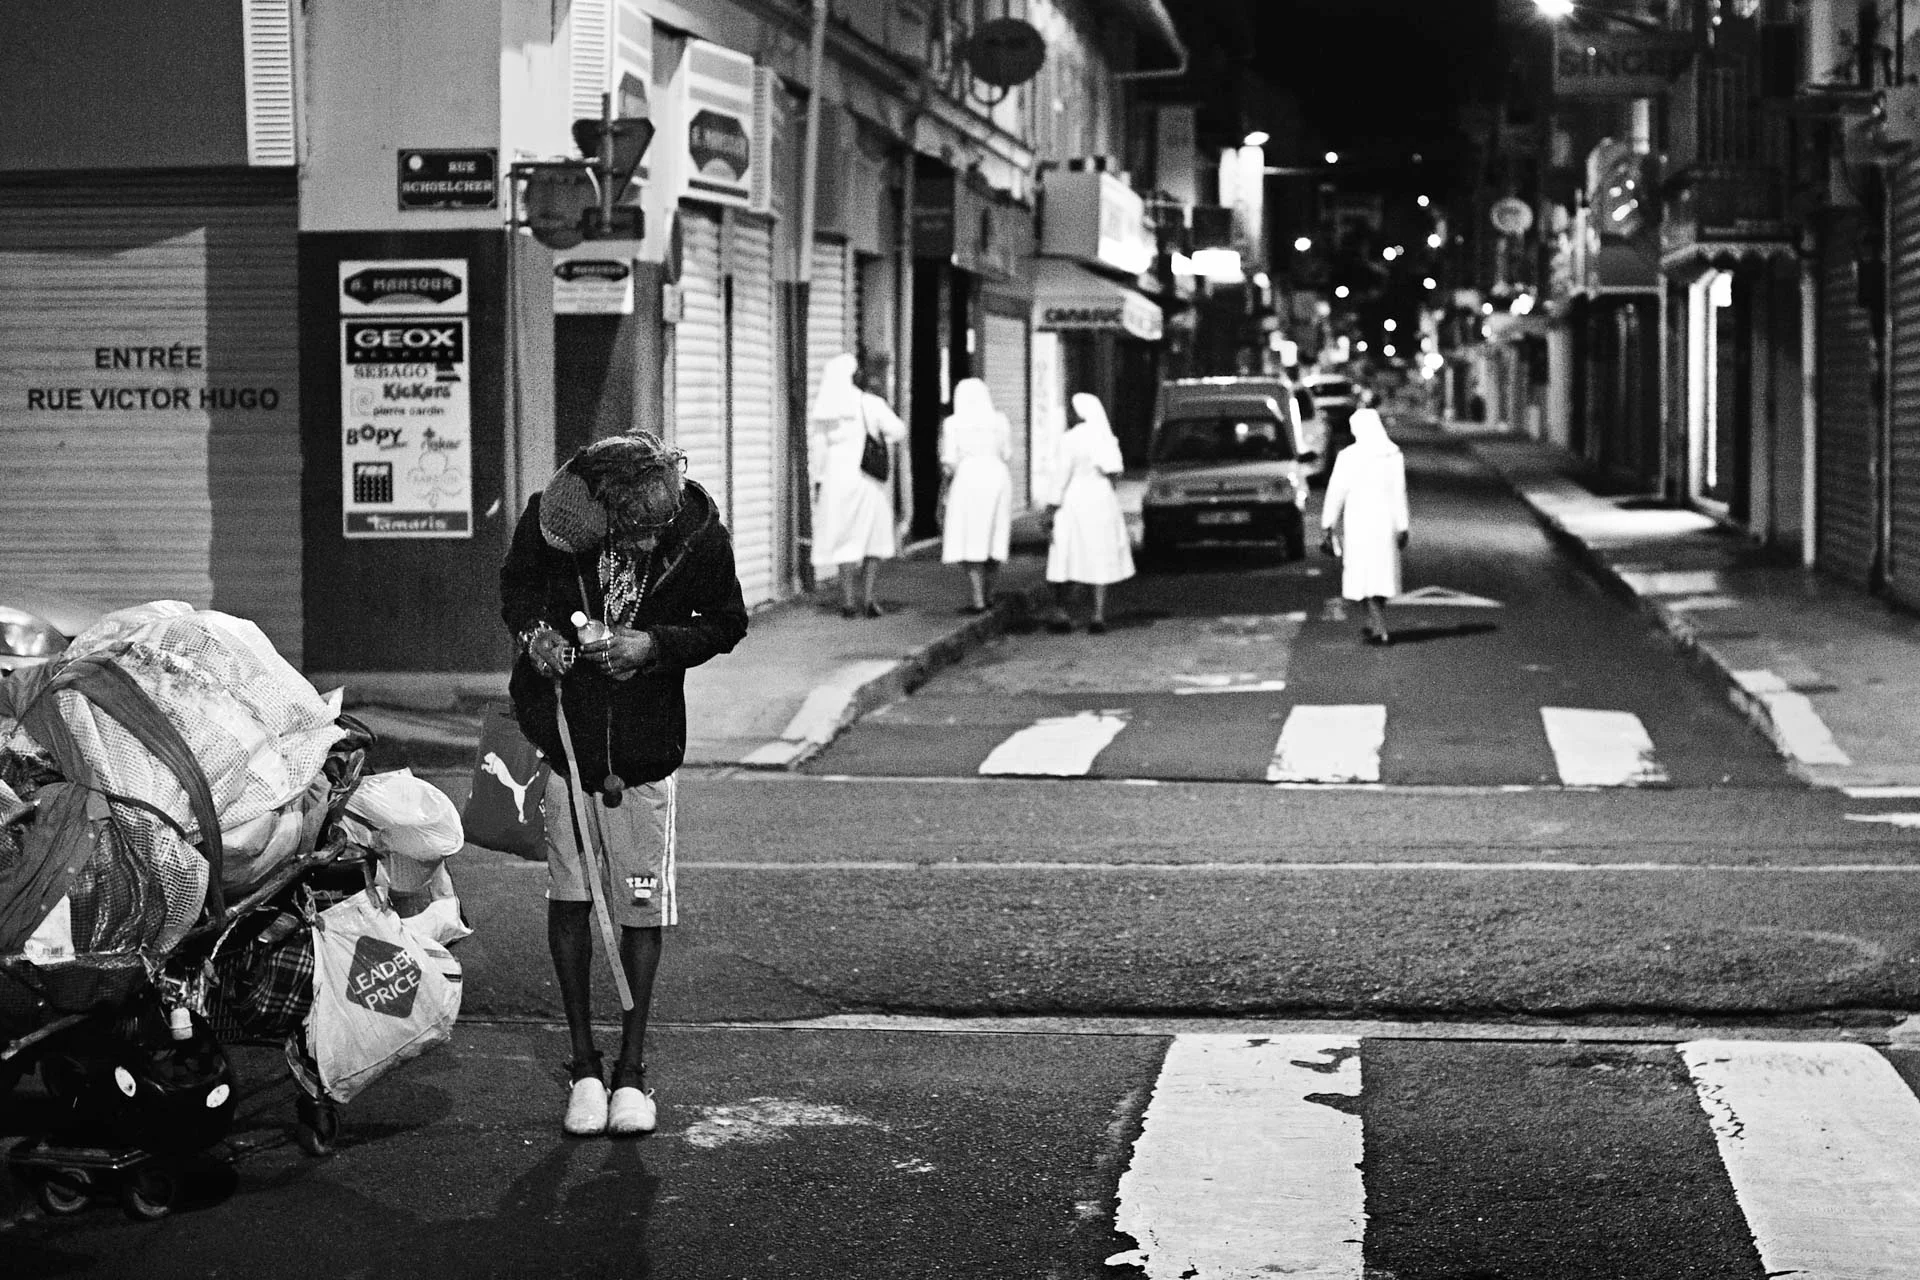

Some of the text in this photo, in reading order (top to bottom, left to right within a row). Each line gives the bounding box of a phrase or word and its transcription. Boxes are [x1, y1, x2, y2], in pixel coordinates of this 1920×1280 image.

[1558, 49, 1688, 78] SINGE
[447, 161, 476, 173] RUE
[401, 181, 493, 193] SCHOELCHER
[354, 328, 455, 348] GEOX
[95, 341, 203, 369] ENTRÉE
[354, 363, 428, 378] SEBAGO
[27, 387, 280, 411] RUE VICTOR HUGO
[348, 947, 416, 995] LEADER
[365, 970, 420, 1011] PRICE
